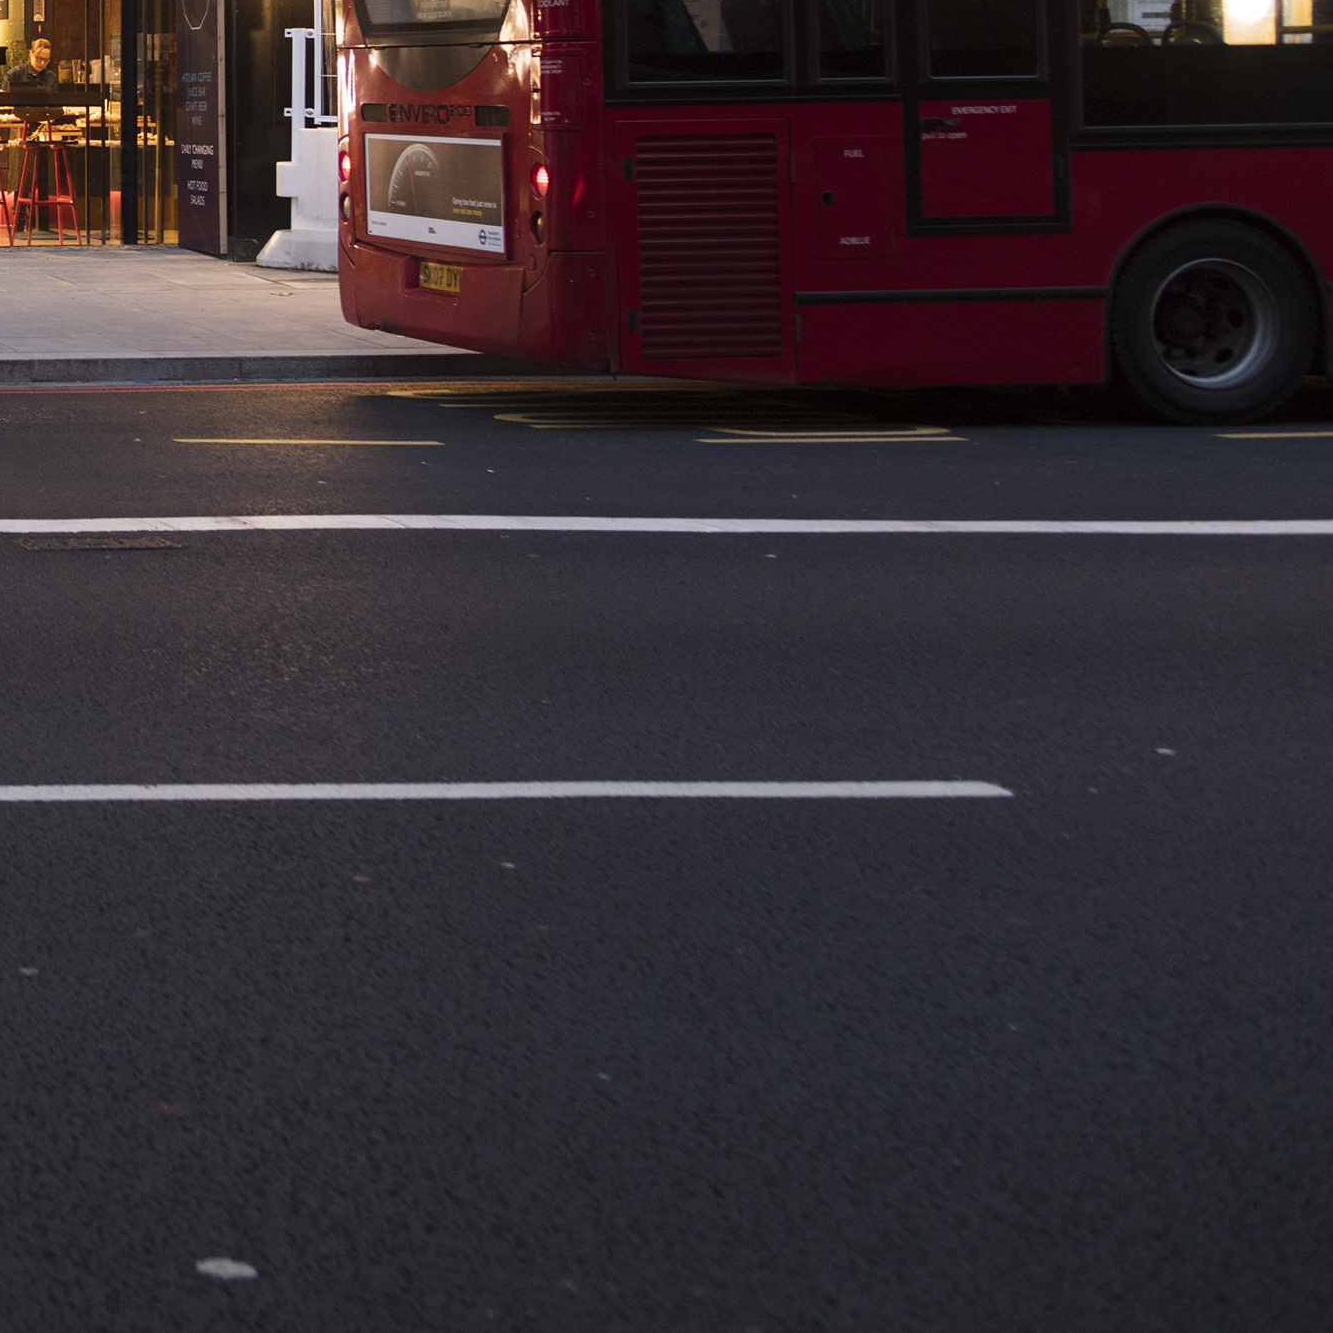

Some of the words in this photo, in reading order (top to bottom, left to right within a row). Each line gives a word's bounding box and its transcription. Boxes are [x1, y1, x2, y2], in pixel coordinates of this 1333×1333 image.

[197, 71, 212, 82] COFFEE
[198, 87, 206, 97] BAR
[186, 102, 198, 112] CRAFT
[198, 101, 208, 111] BEER
[389, 103, 450, 124] ENVIRO
[191, 116, 203, 126] WINE
[181, 144, 192, 155] DAILY
[192, 144, 214, 156] CHANGING
[842, 150, 864, 158] FUEL
[191, 159, 204, 170] MENU
[187, 180, 196, 191] HOT
[196, 181, 208, 192] FOOD
[190, 195, 206, 206] SALADS
[839, 236, 871, 245] ADBLUE
